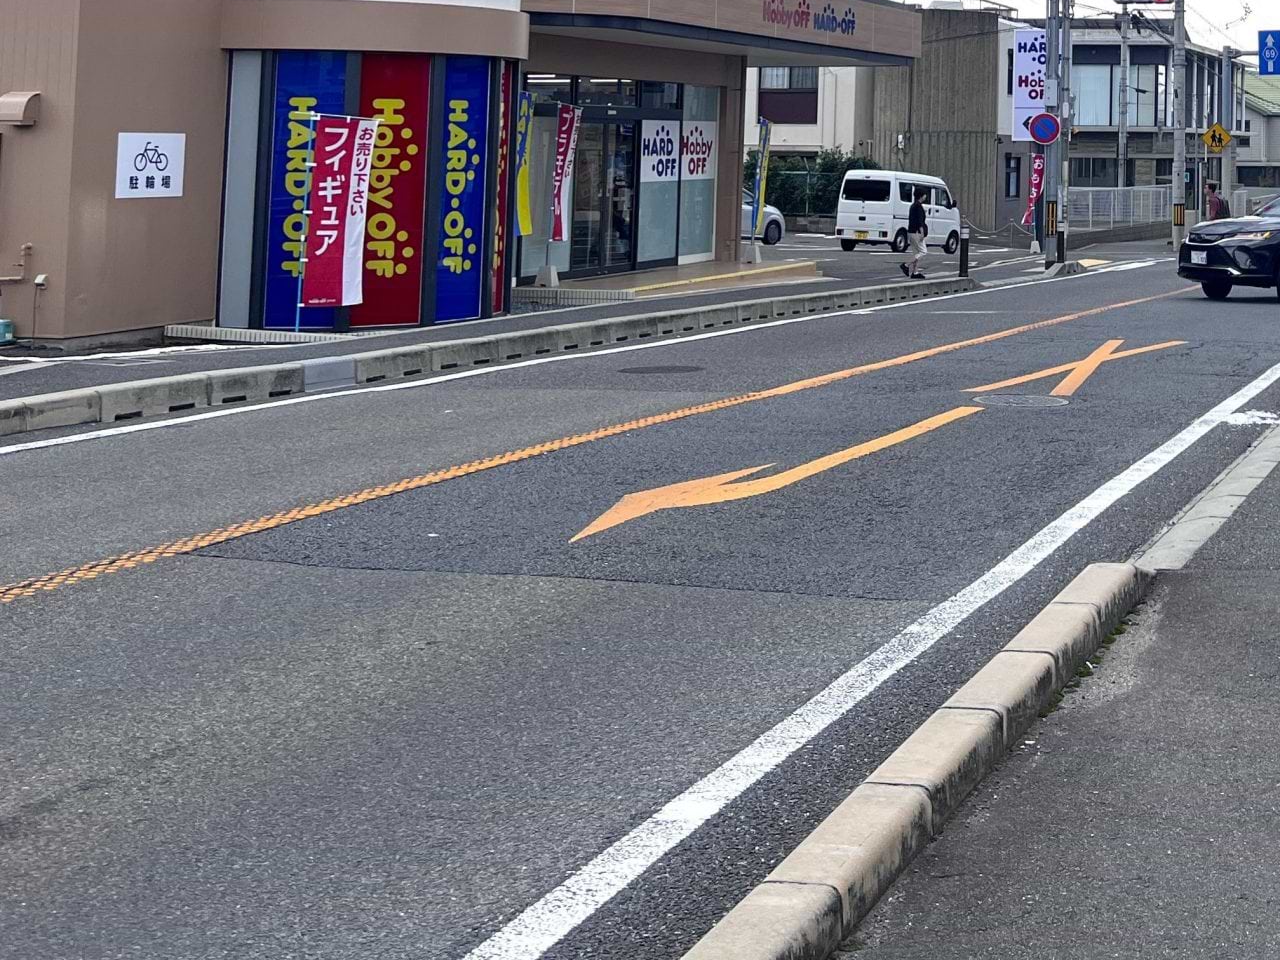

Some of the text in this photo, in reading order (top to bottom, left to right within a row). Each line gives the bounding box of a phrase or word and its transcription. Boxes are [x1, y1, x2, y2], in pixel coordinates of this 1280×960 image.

[1018, 41, 1047, 53] HAR
[1265, 49, 1276, 58] 69
[1018, 74, 1045, 88] Hob
[642, 138, 674, 157] HARD
[681, 135, 713, 158] Hobby
[350, 127, 375, 216] お売り下さい
[688, 157, 707, 176] OFF
[129, 175, 171, 190] 駐輪場
